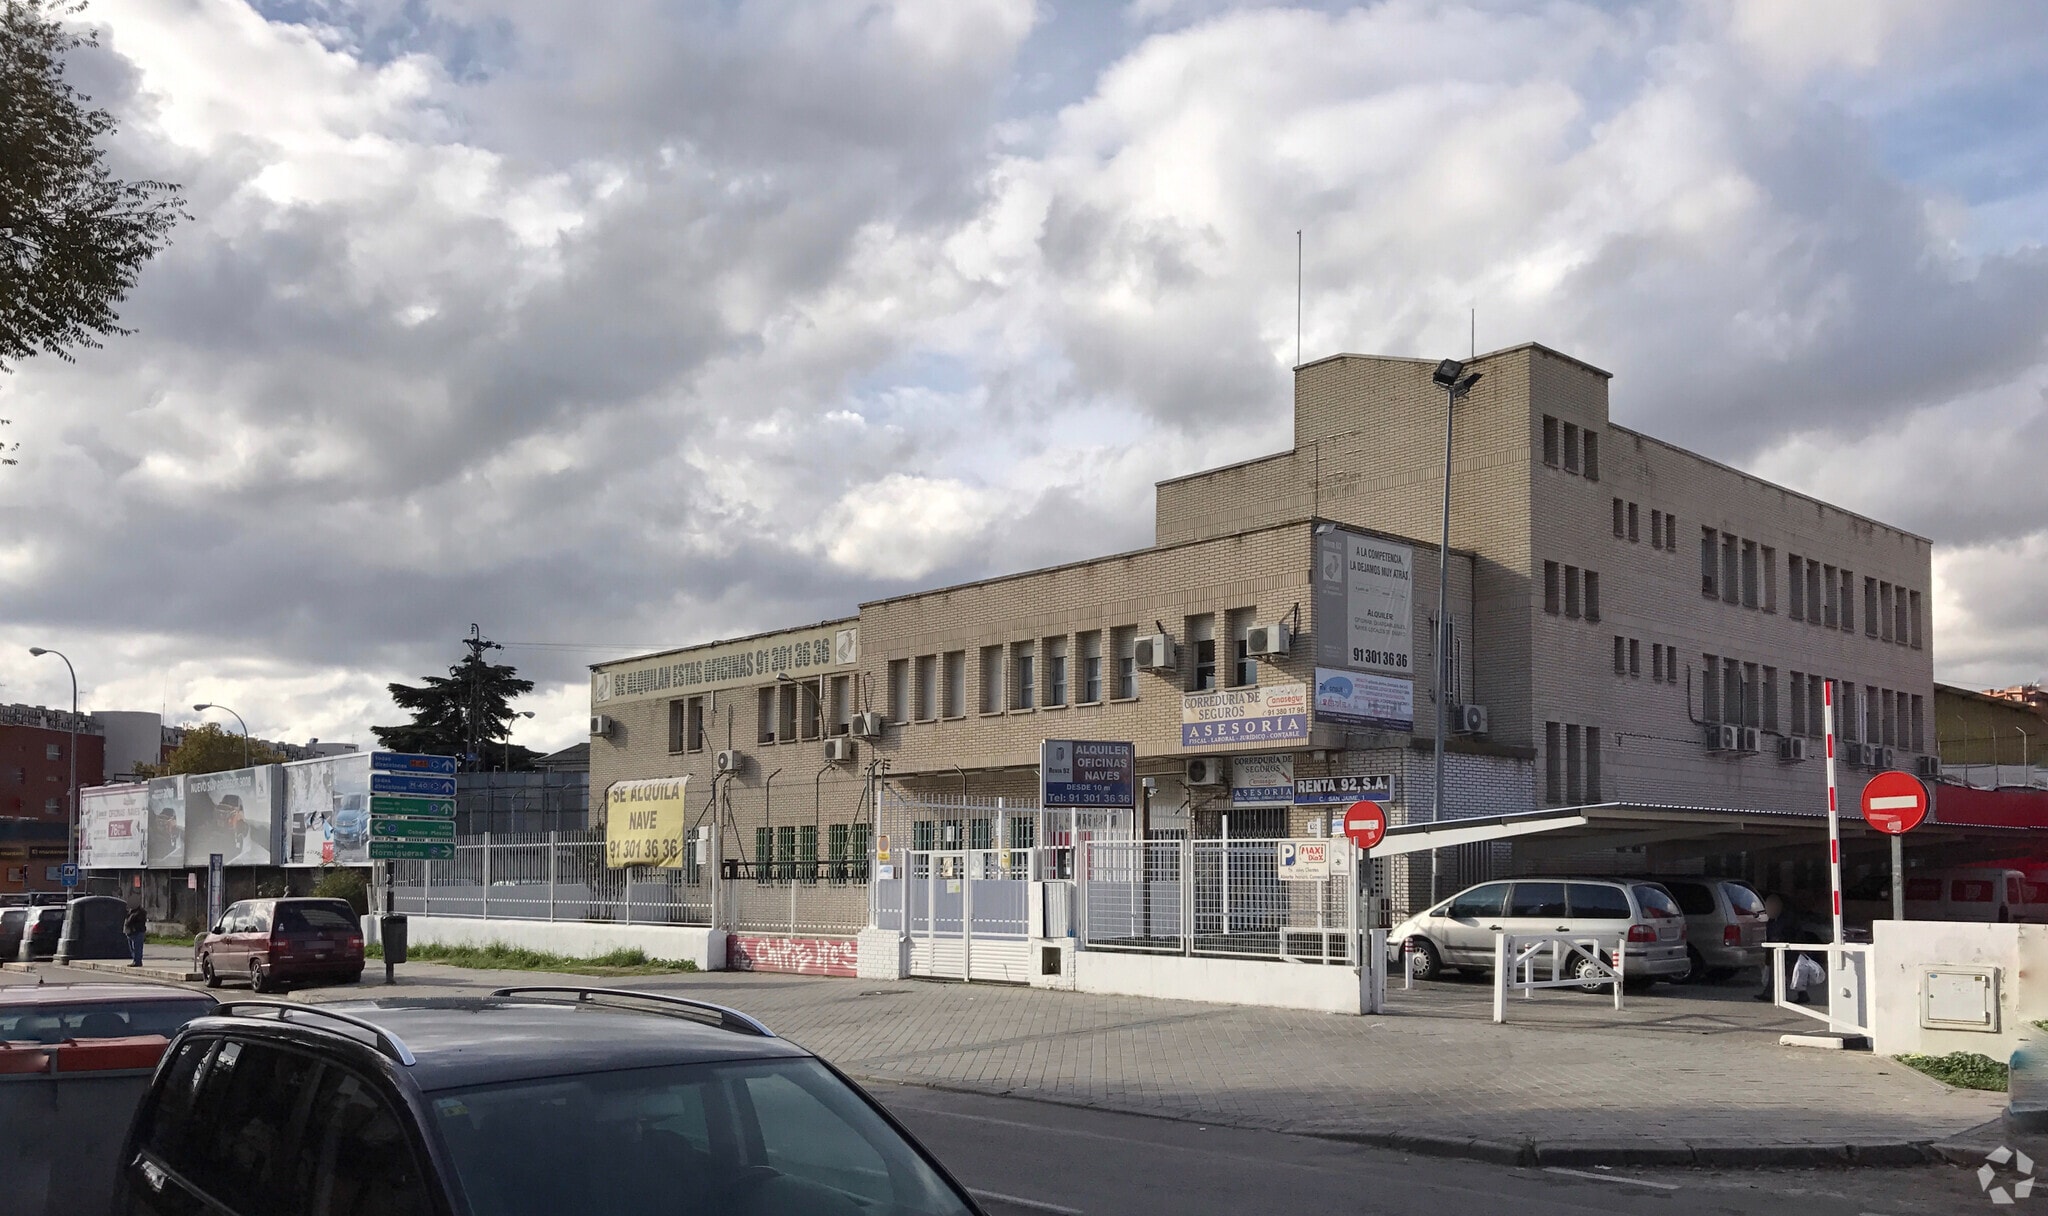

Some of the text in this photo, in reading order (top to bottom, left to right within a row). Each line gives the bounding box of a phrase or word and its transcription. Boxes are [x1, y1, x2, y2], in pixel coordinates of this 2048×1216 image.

[1361, 547, 1367, 557] LA
[1350, 560, 1356, 571] LA
[1357, 562, 1380, 576] DEJAMOS
[1381, 567, 1392, 578] MUY
[1353, 647, 1364, 662] 91
[1365, 649, 1380, 664] 301
[1383, 651, 1394, 666] 36
[1396, 653, 1408, 668] 36
[615, 638, 830, 696] SE ALQUILAN ESTAS OFICINAS 91 301 36 36
[1184, 691, 1260, 709] CORREDURÍA DE
[1199, 706, 1245, 720] SEGUROS
[1189, 717, 1299, 738] ASESORÍA
[1270, 731, 1300, 739] CONTABLE
[1076, 745, 1129, 755] ALQUILER
[1078, 758, 1127, 768] OFICINAS
[1282, 755, 1293, 763] DE
[1085, 771, 1120, 780] NAVES
[613, 782, 679, 803] SE ALQUILA
[1298, 780, 1336, 793] RENTA
[1048, 793, 1130, 803] Tel: 91 301 36 36
[629, 810, 658, 830] NAVE
[610, 838, 678, 859] 91 301 36 36
[1282, 844, 1295, 866] P
